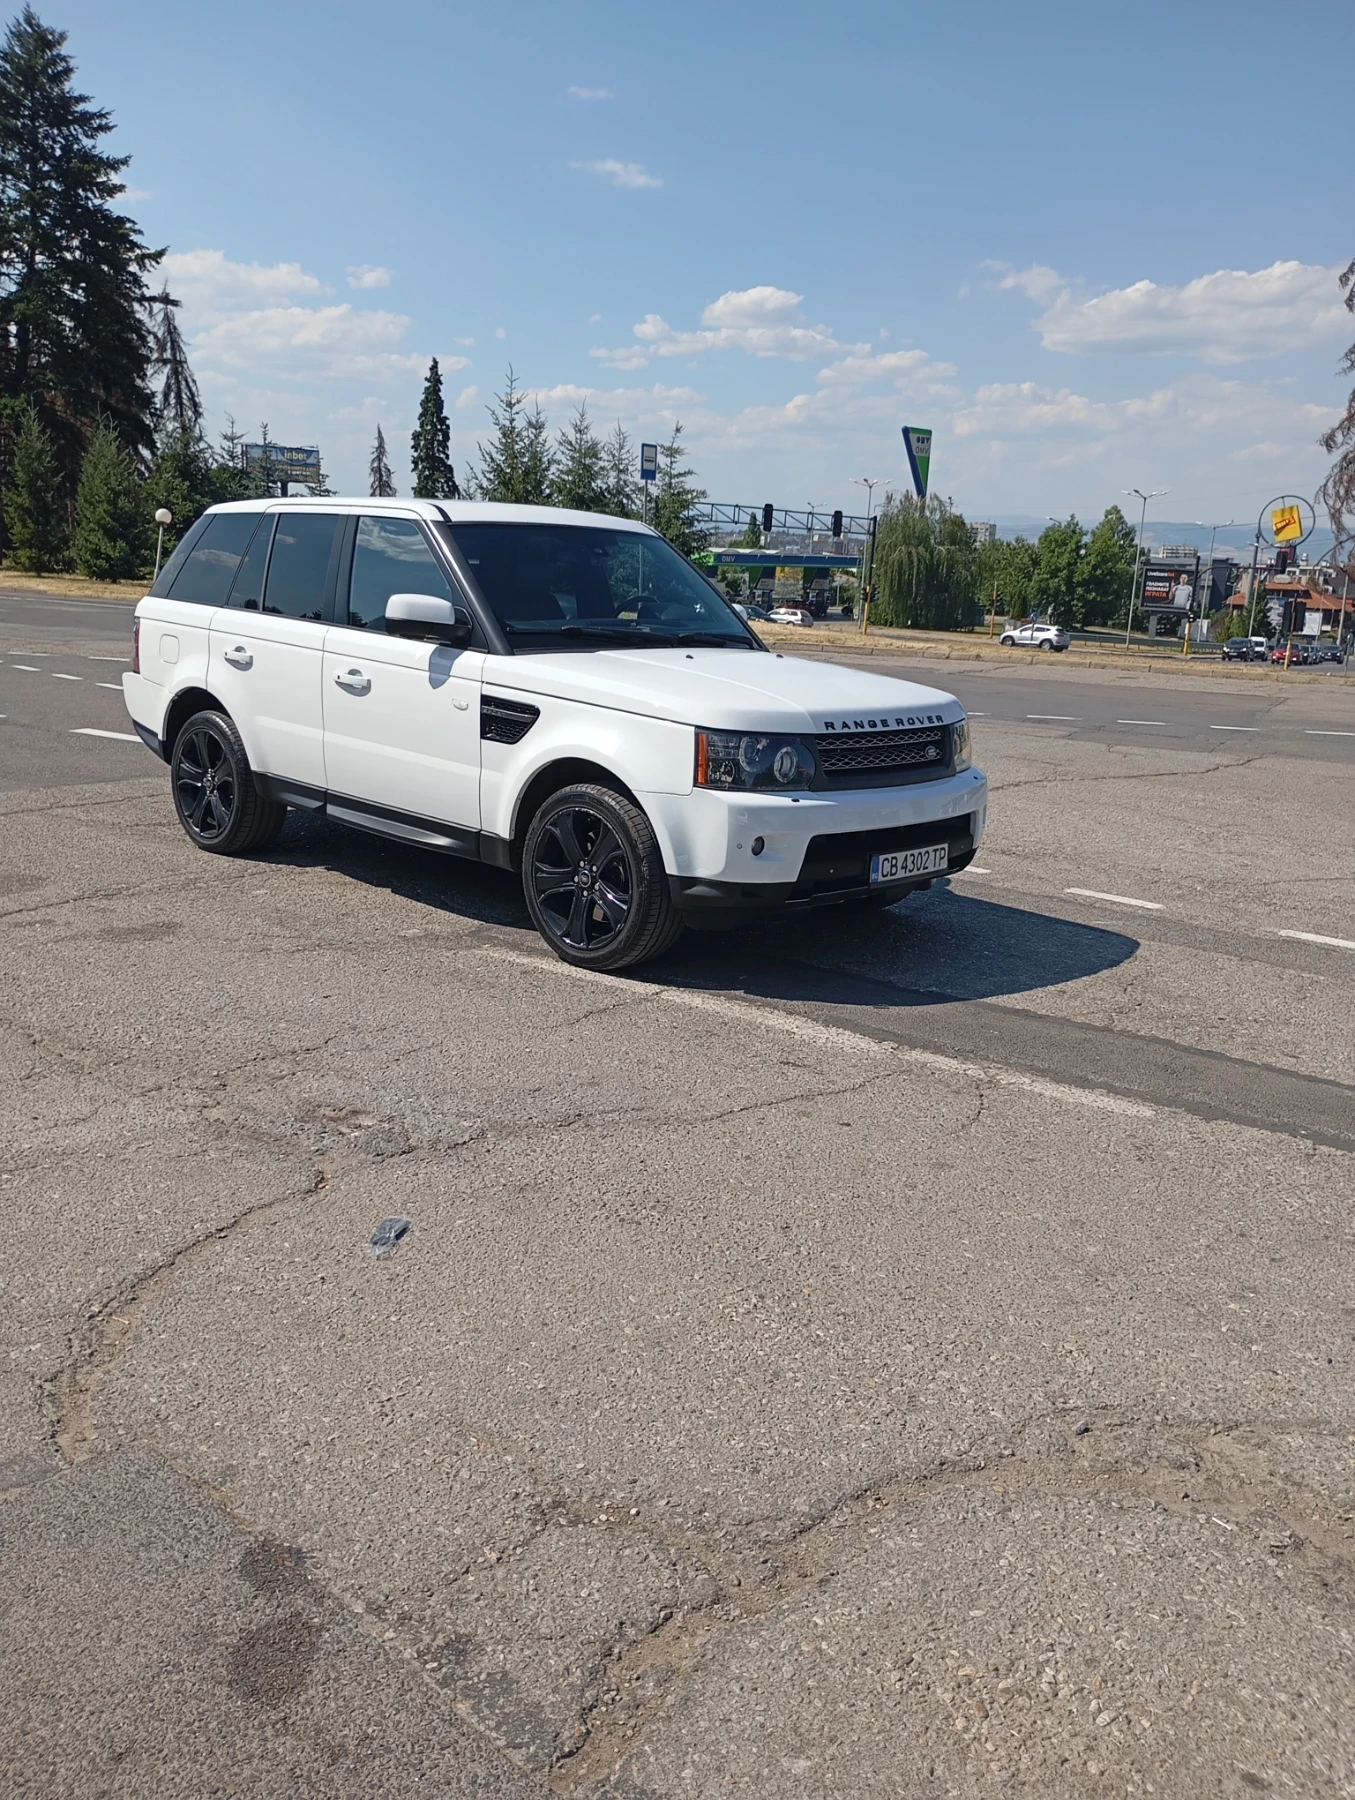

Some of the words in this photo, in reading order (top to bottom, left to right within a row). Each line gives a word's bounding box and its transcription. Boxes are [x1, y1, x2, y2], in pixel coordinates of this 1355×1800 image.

[284, 449, 308, 460] inbet
[721, 555, 736, 563] OMV
[824, 719, 890, 731] RANGE
[895, 715, 944, 727] ROVER
[901, 850, 930, 875] 4302
